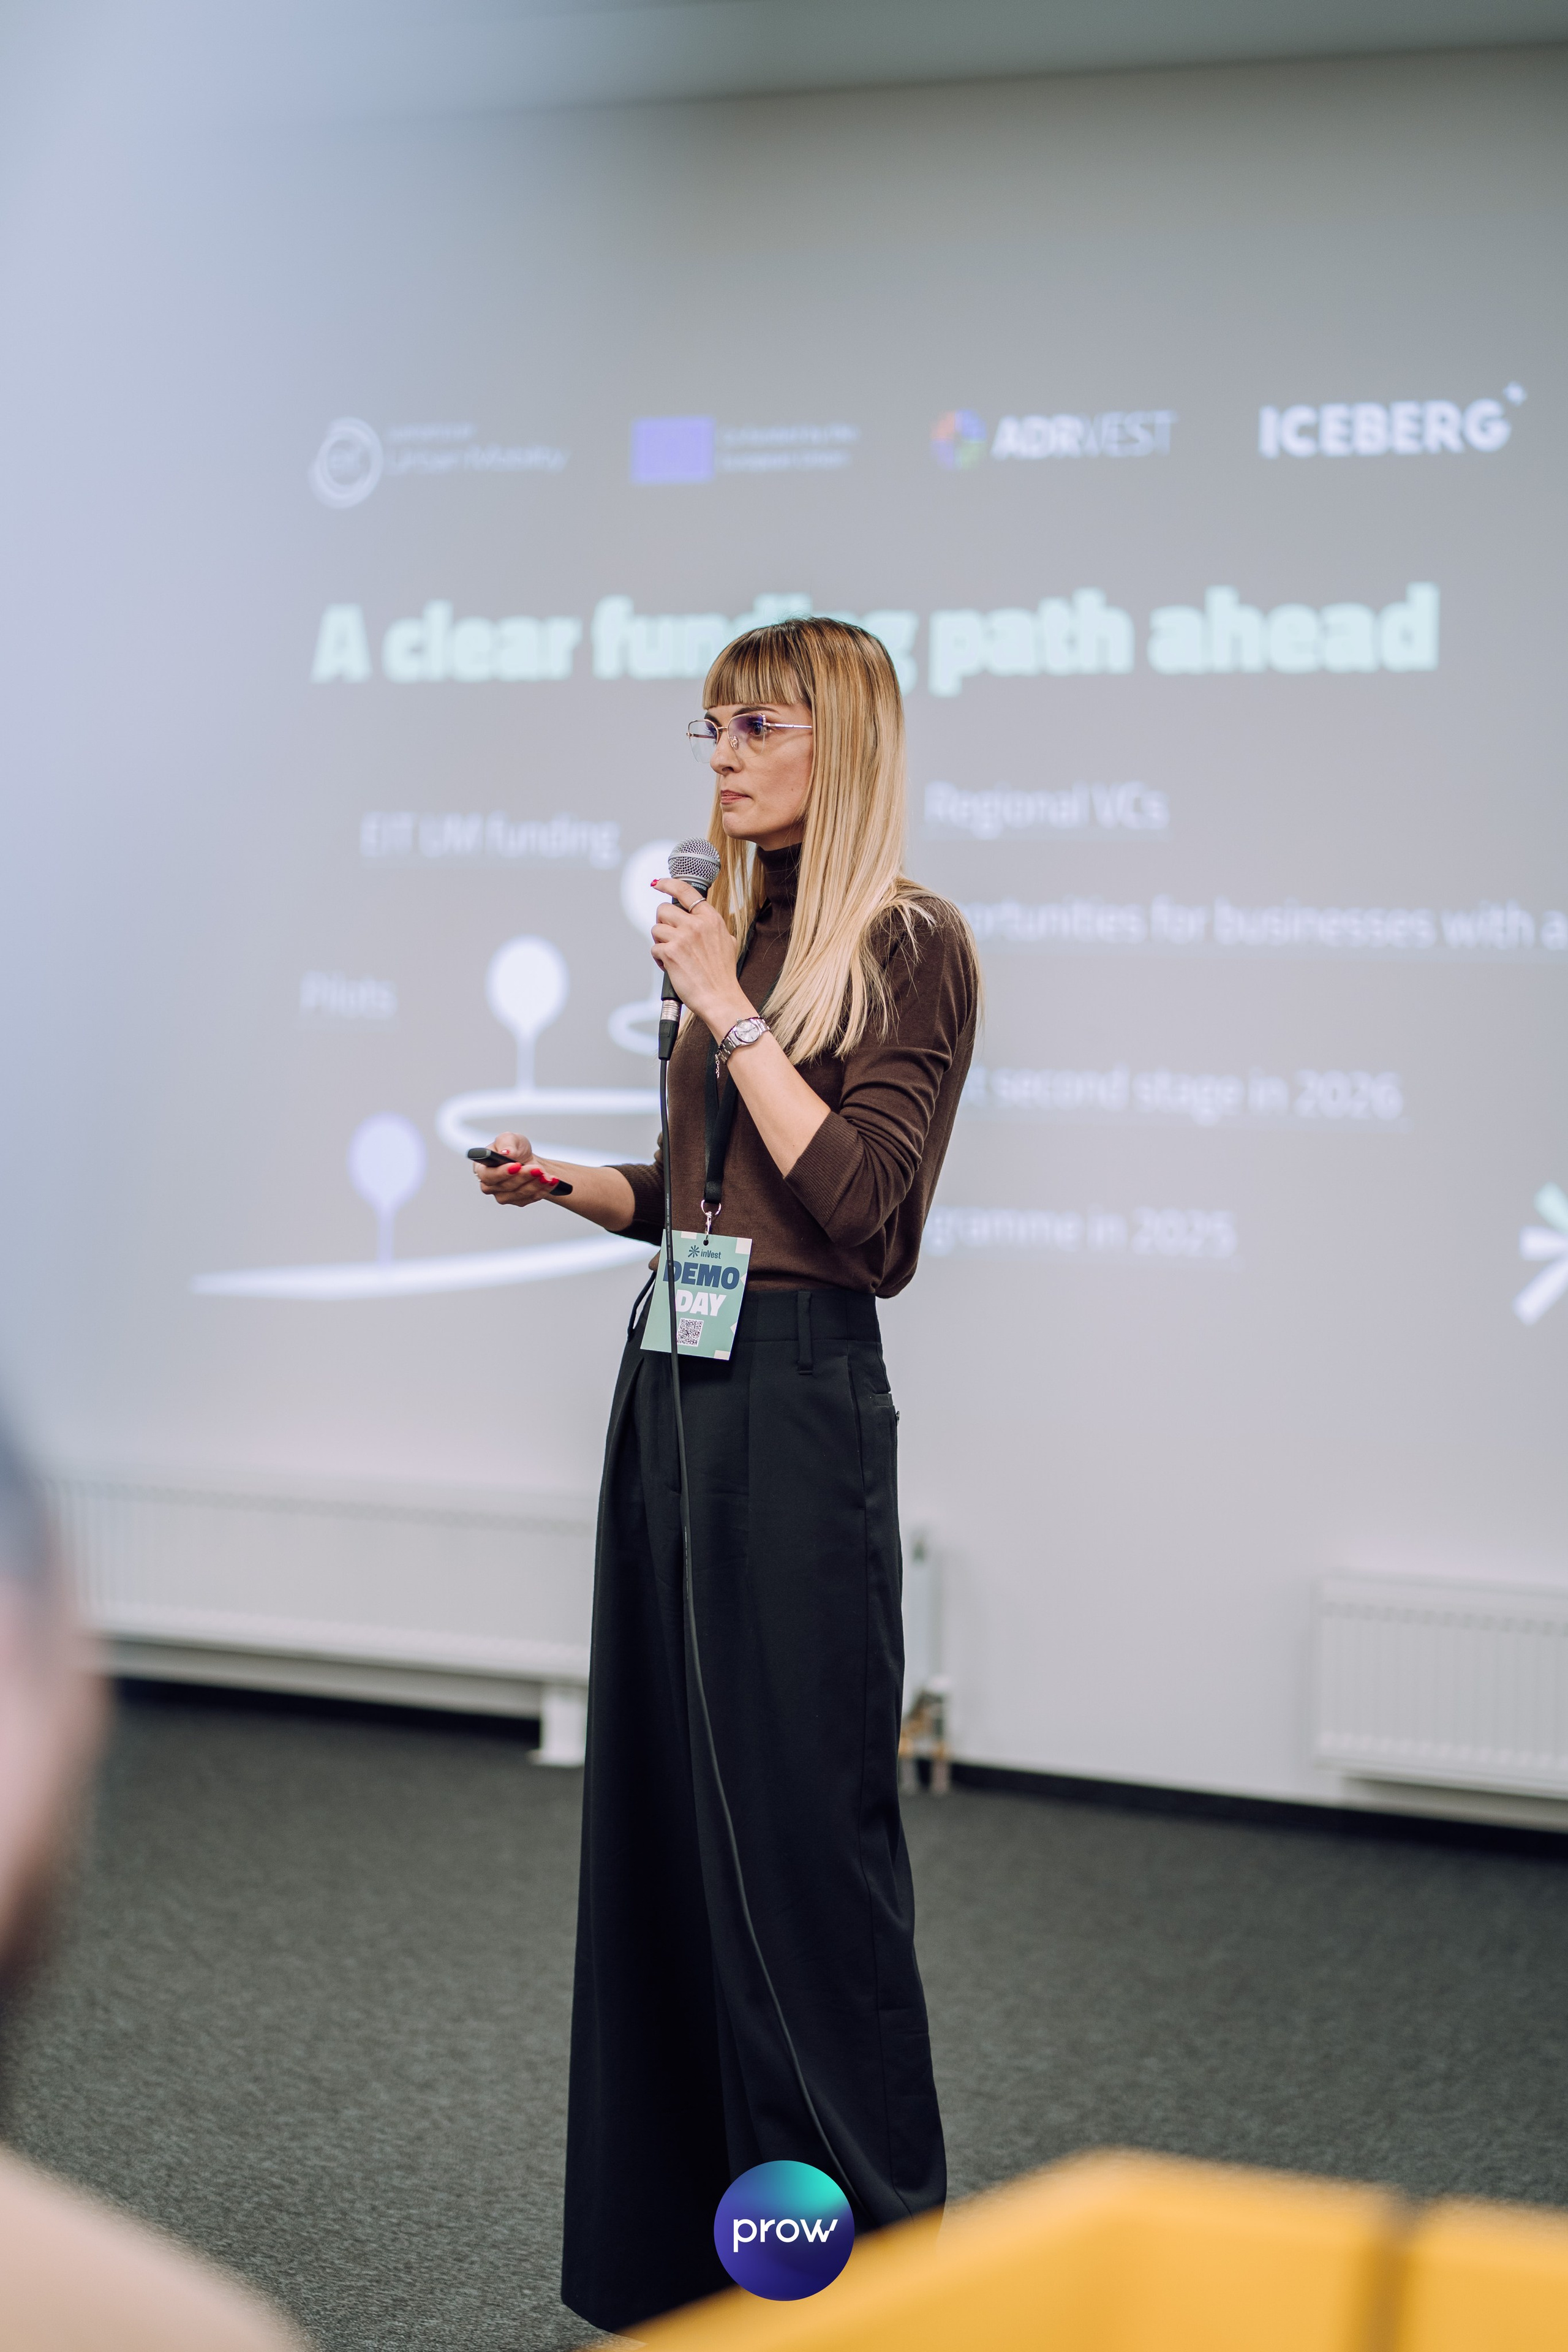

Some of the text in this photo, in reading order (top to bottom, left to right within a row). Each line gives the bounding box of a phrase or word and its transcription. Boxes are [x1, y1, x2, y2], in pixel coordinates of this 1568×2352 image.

[991, 409, 1178, 460] ADRVEST
[1259, 399, 1512, 458] ICEBERG
[312, 603, 370, 682] A
[385, 601, 579, 681] clear
[930, 590, 1133, 696] path
[1149, 584, 1438, 671] ahead
[926, 781, 1170, 838] Regional VCs
[360, 810, 417, 857] EIT
[485, 809, 620, 869] funding
[1152, 896, 1209, 944] for
[1215, 896, 1437, 948] businesses
[1441, 898, 1536, 948] with
[991, 1063, 1128, 1110] second
[1133, 1069, 1243, 1126] stage
[1248, 1067, 1287, 1114] in
[1294, 1071, 1405, 1118] 2026
[700, 1248, 722, 1259] inVest
[925, 1205, 1237, 1255] gramme in 2025
[663, 1259, 740, 1290] DEMO
[675, 1289, 727, 1317] DAY
